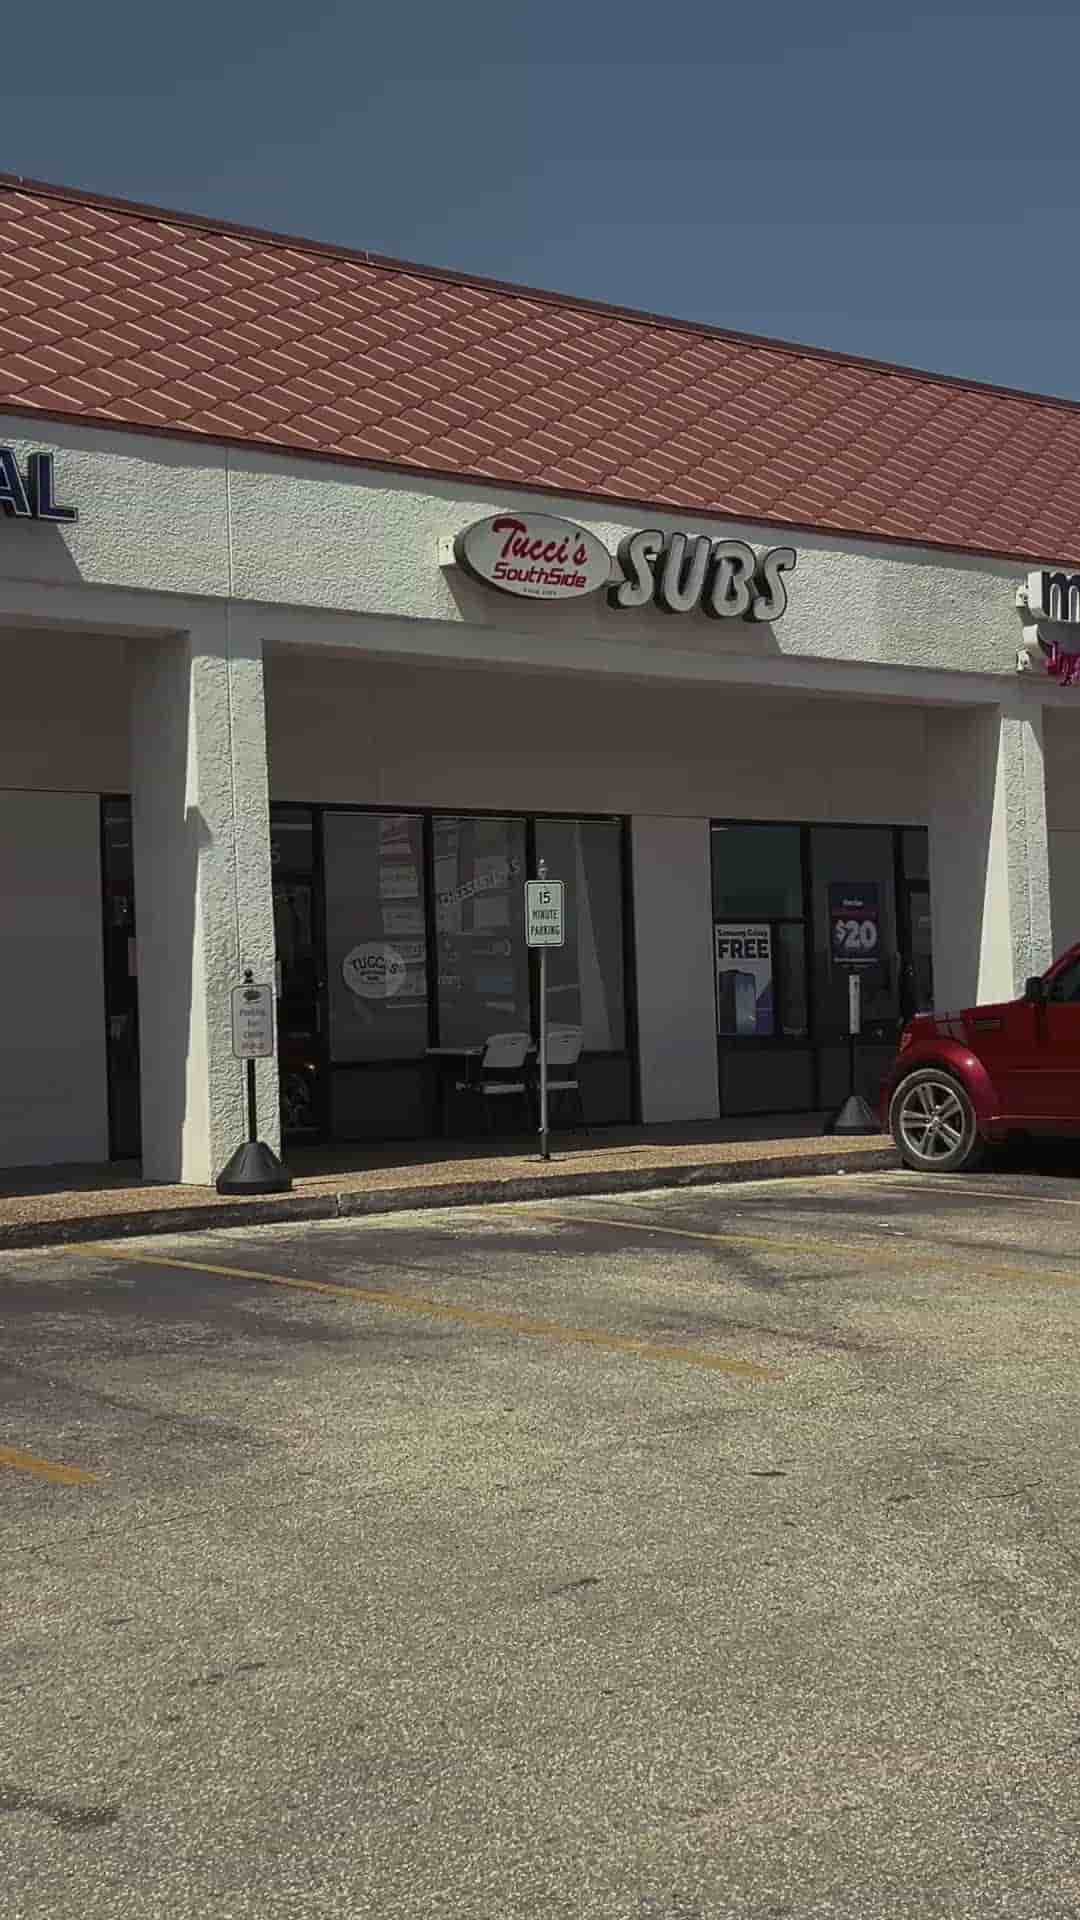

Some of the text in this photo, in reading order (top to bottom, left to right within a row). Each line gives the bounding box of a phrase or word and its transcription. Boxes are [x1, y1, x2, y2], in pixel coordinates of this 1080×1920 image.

[492, 518, 588, 565] Tucci's
[493, 562, 586, 588] SouthSide
[613, 529, 797, 622] SUBS
[538, 891, 551, 905] 15
[532, 909, 559, 921] MINUTE
[531, 925, 560, 936] PARKING
[832, 919, 878, 951] $20
[718, 939, 769, 959] FREE
